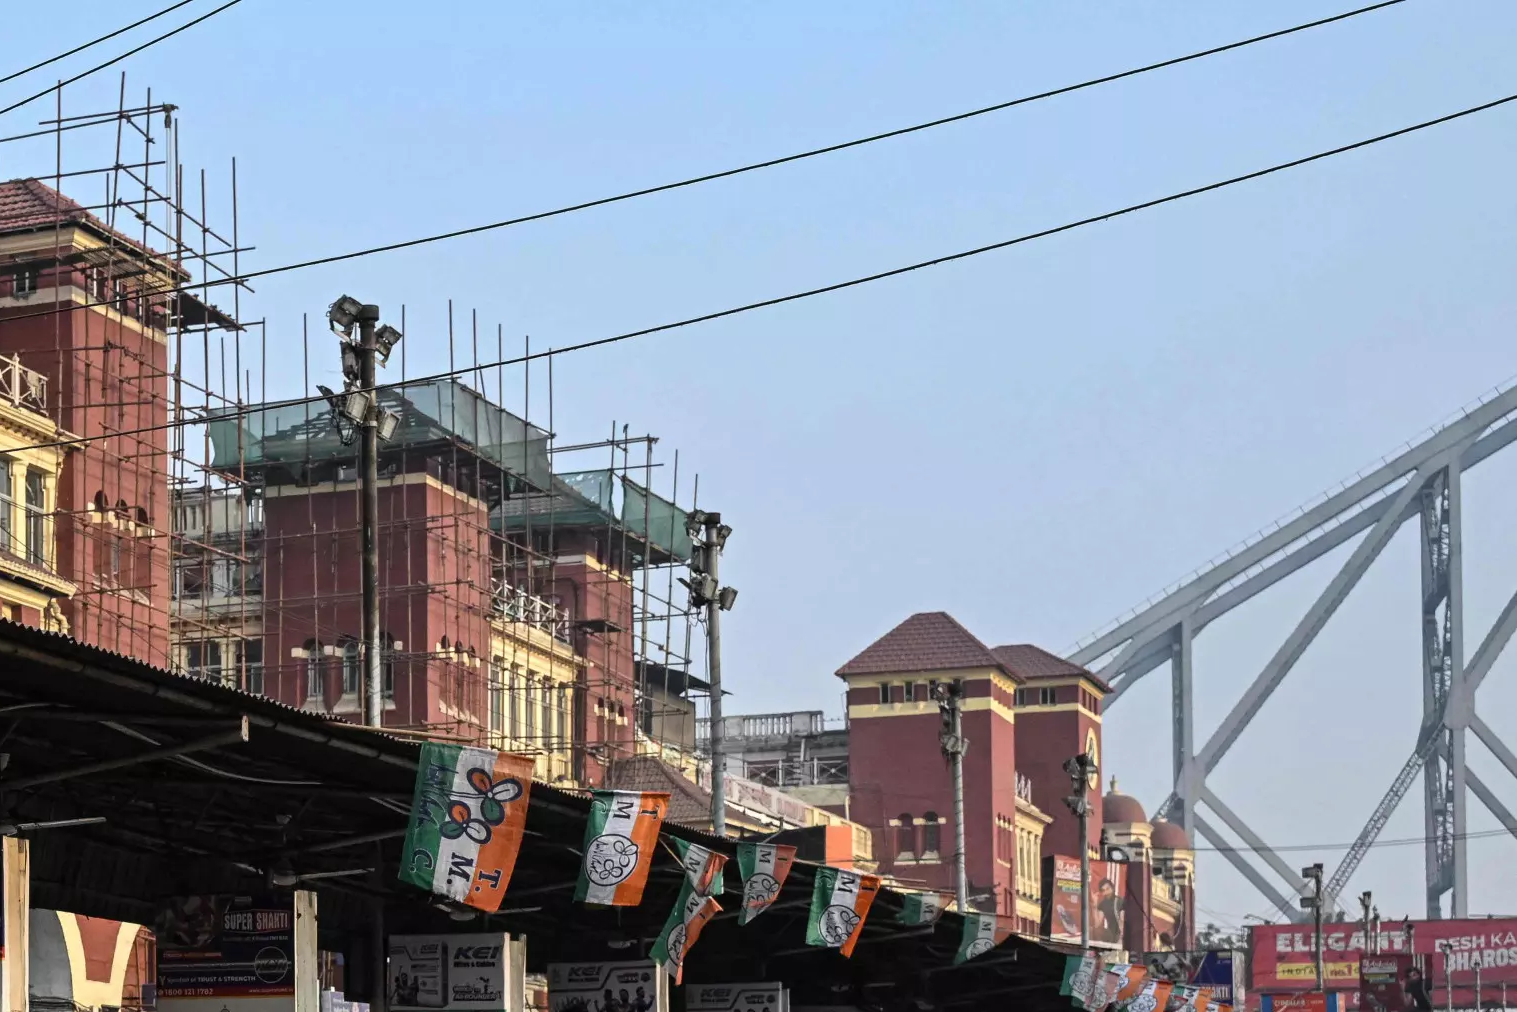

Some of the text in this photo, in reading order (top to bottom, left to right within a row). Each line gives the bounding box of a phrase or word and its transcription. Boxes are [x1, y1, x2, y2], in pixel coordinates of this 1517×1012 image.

[612, 800, 635, 820] M
[446, 852, 475, 885] M.
[837, 877, 857, 894] M
[224, 911, 288, 931] SUPER SHAKTI
[1435, 931, 1517, 952] DESH KA
[454, 946, 502, 960] KEI
[568, 966, 602, 977] KEI
